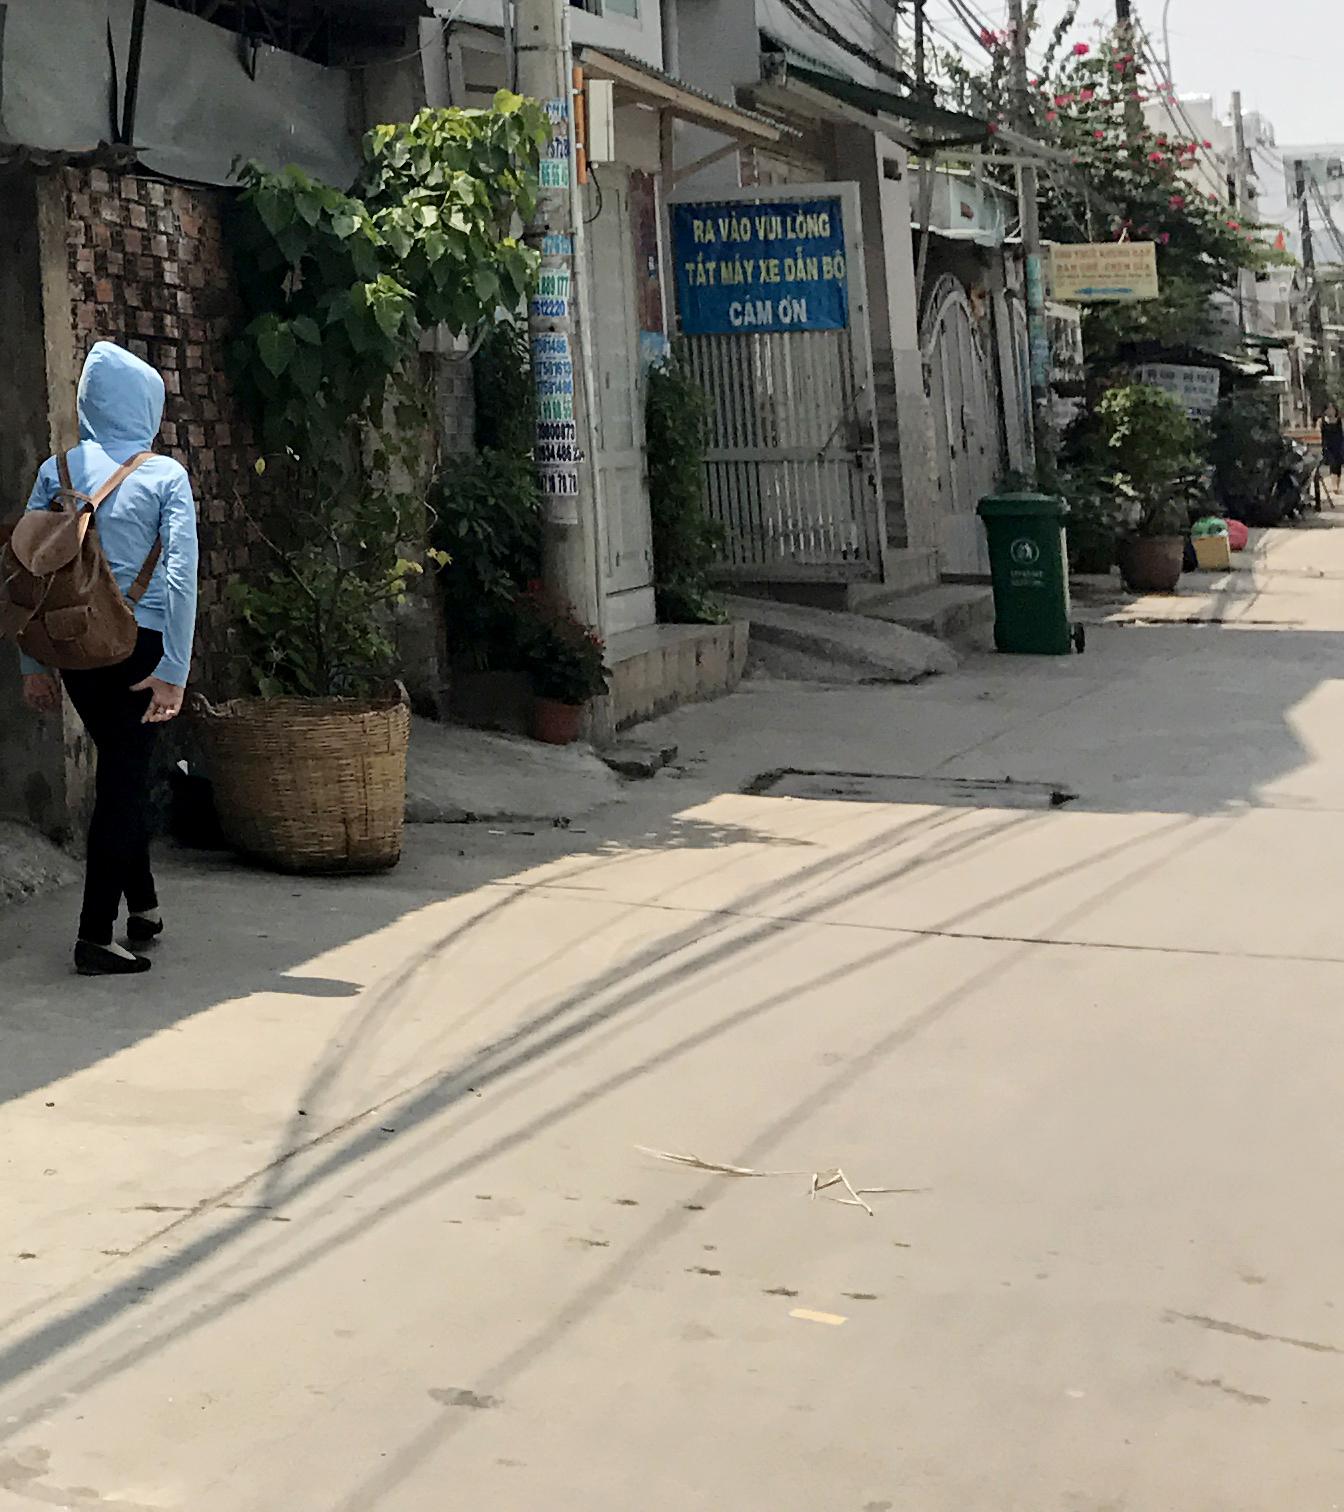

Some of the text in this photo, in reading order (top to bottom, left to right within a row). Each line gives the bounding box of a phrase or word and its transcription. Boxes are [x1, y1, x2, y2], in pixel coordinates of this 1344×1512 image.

[693, 219, 716, 244] RA
[718, 210, 751, 242] VÀO
[755, 215, 782, 241] VUI
[759, 258, 780, 284] XE
